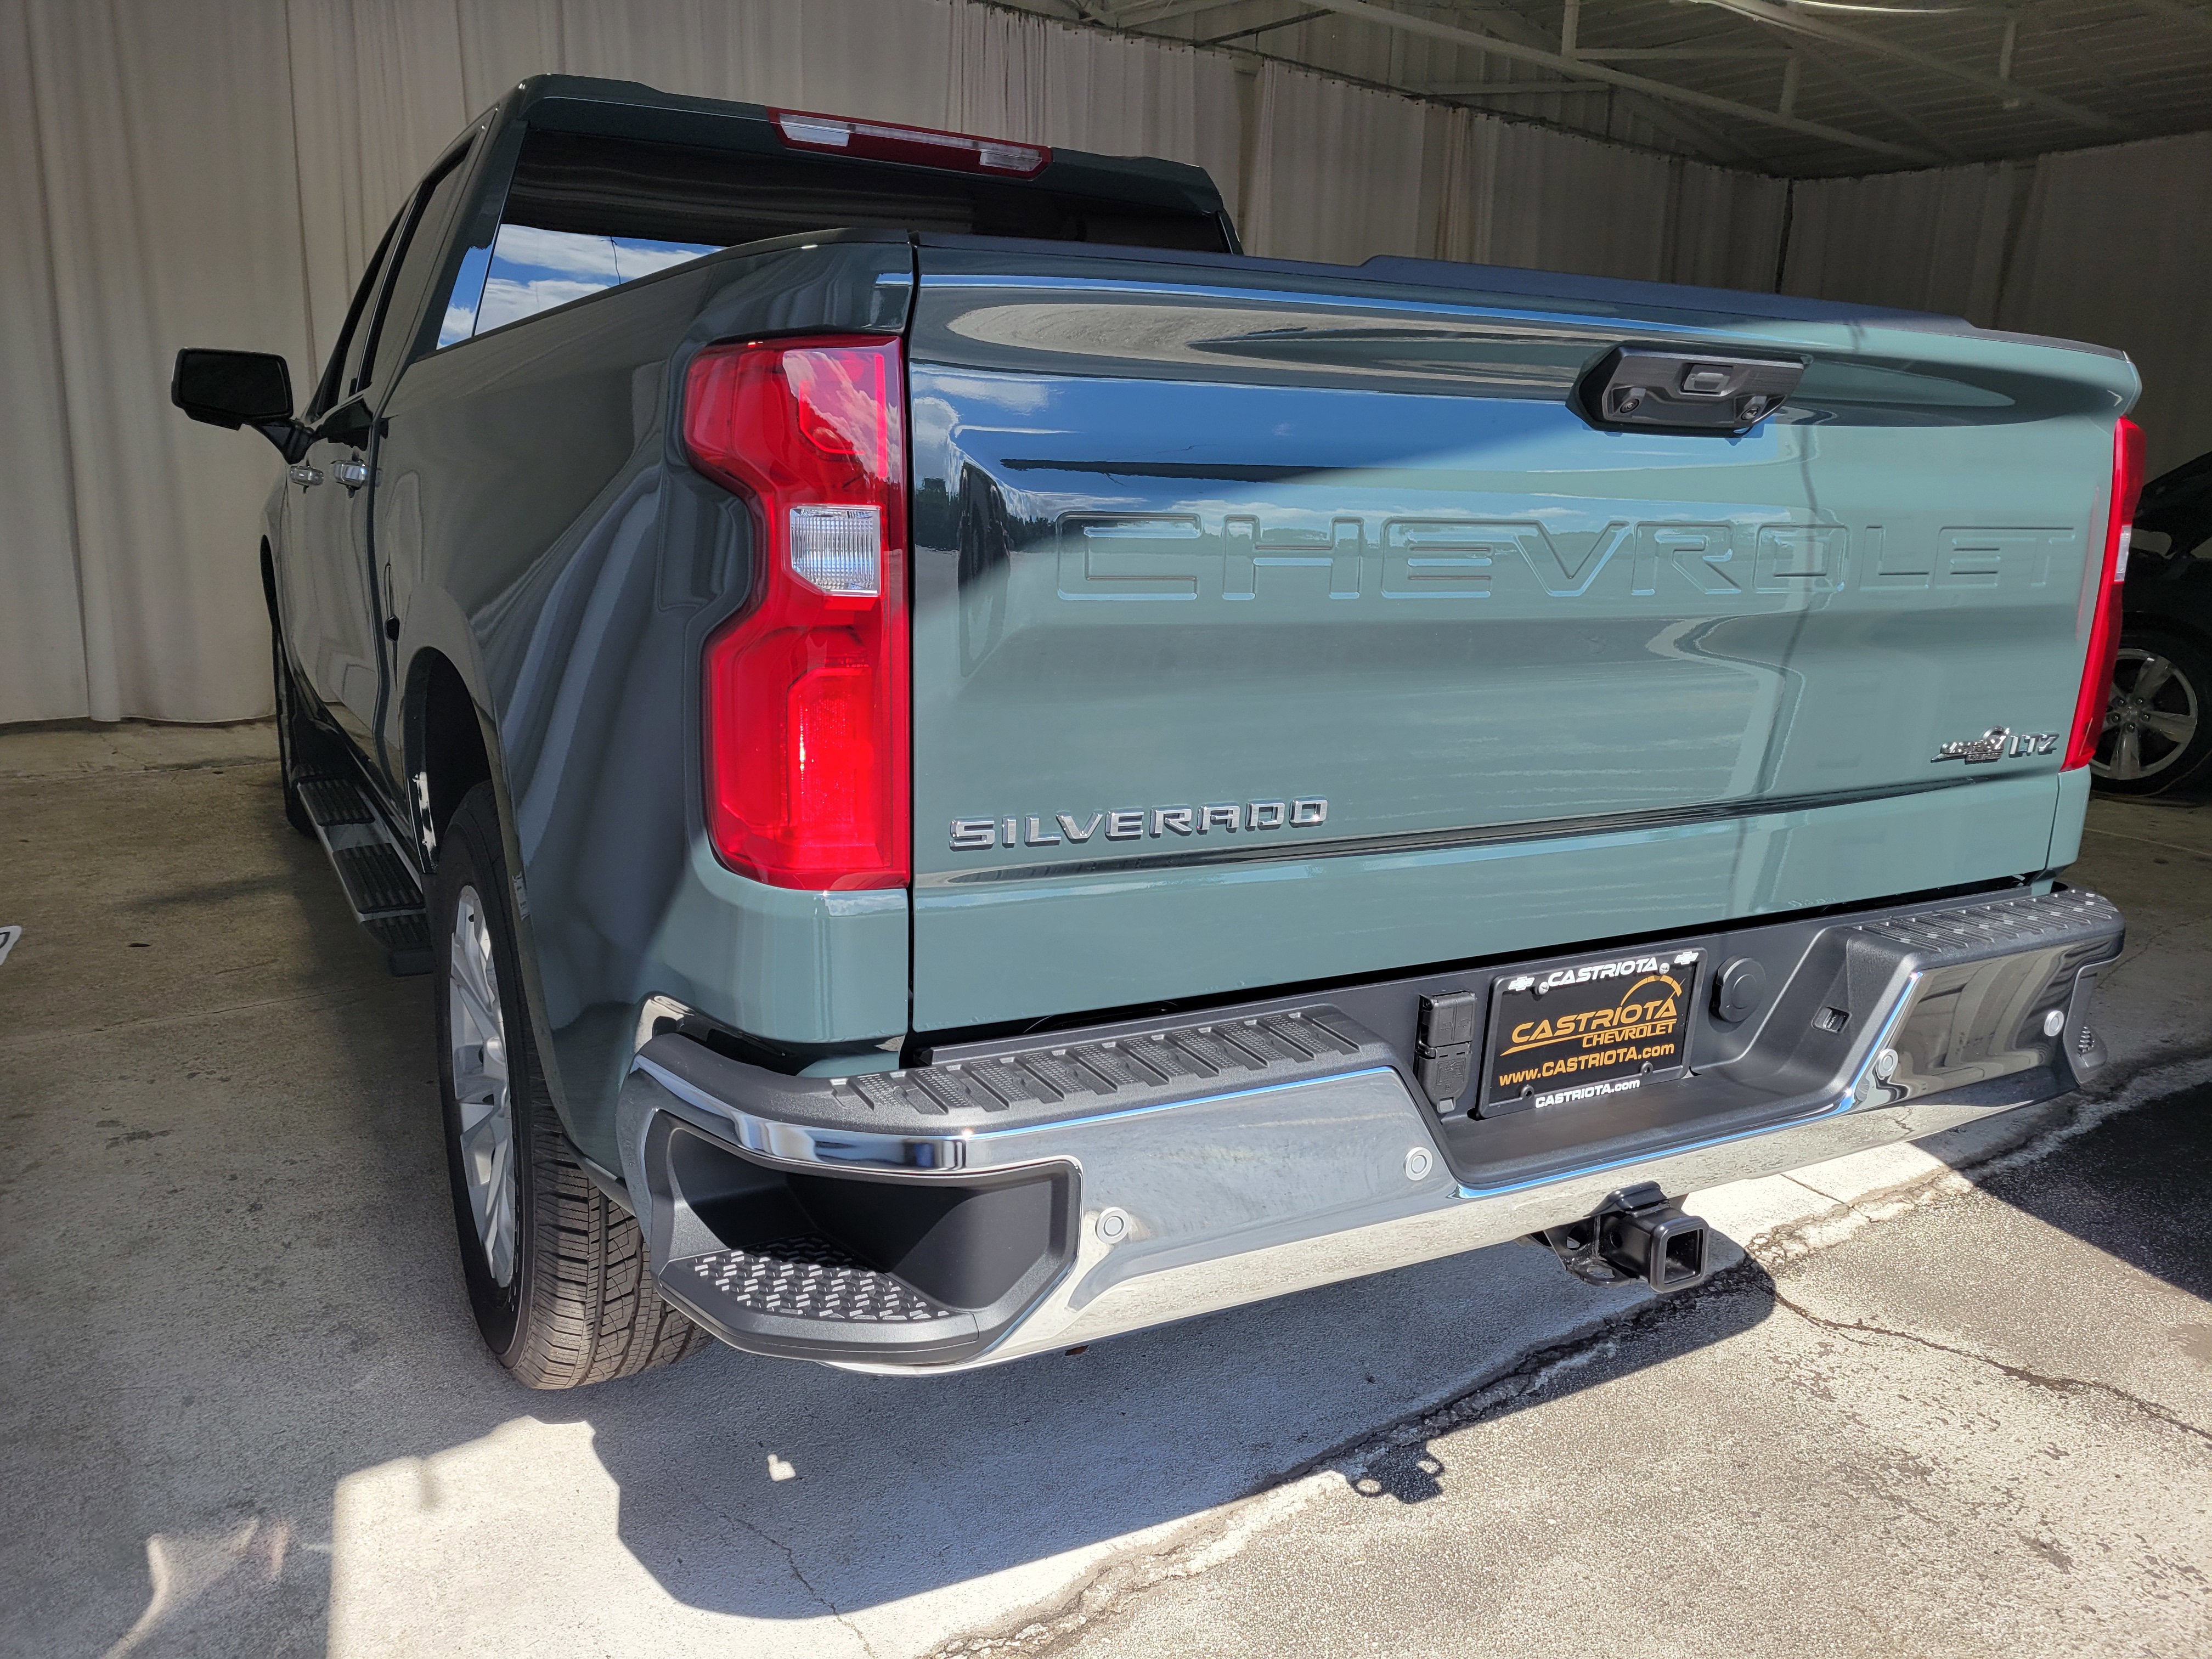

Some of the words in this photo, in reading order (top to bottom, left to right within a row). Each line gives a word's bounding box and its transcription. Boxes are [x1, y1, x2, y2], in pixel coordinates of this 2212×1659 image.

[1056, 511, 2076, 601] CHEVROLET
[2008, 733, 2059, 758] LTZ
[949, 796, 1329, 851] SILVERADO
[1548, 957, 1658, 987] CASTRIOTA
[1511, 998, 1677, 1043] CASTRIOTA
[1582, 1020, 1677, 1048] CHEVROLET
[1499, 1043, 1675, 1086] www.CASTRIOTA.com
[1535, 1079, 1640, 1108] CASTRIOTA.com
